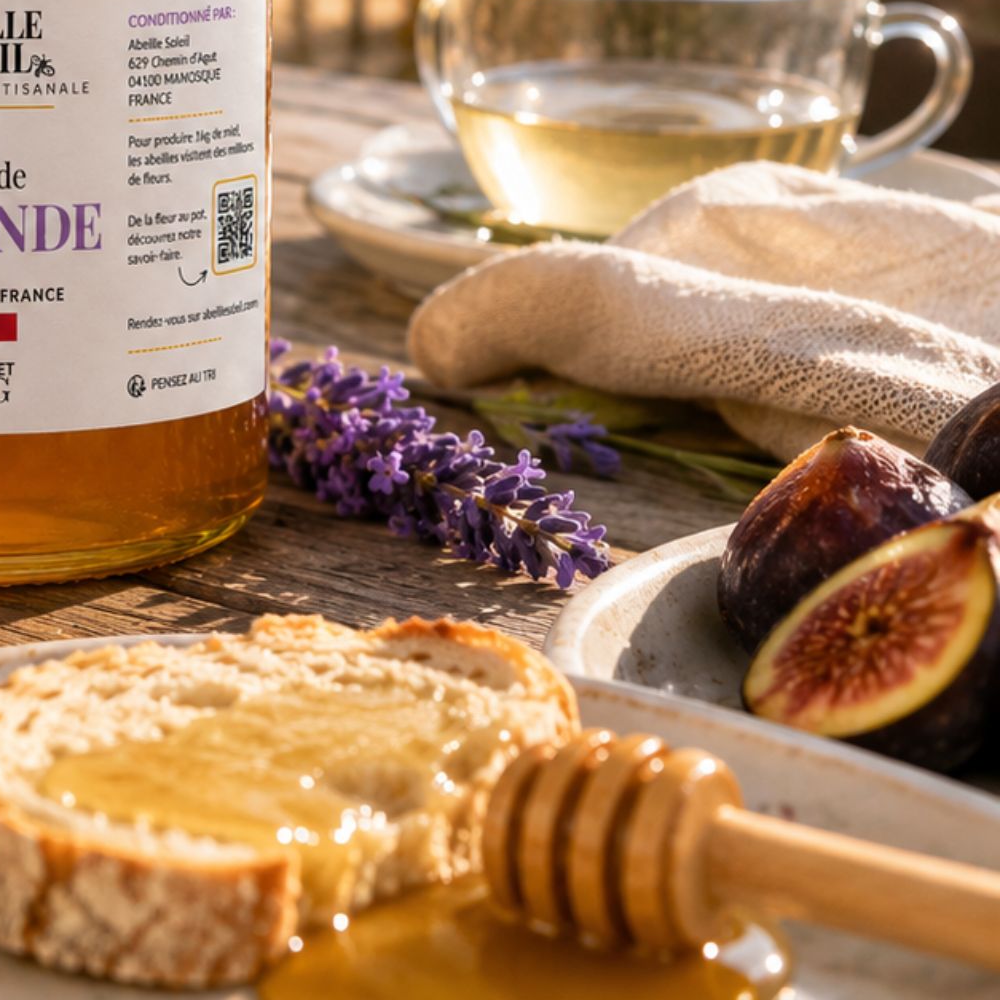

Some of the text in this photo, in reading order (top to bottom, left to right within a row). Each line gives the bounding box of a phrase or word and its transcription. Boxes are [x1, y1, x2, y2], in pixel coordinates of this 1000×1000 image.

[129, 5, 210, 27] CONDITIONNÉ
[128, 35, 190, 50] Abeille Soleil
[128, 57, 149, 69] 629
[151, 55, 188, 68] Chemin
[128, 68, 221, 88] 04100 MANOSQUE
[129, 92, 172, 107] FRANCE
[129, 136, 152, 149] Pour
[154, 134, 193, 148] produire
[212, 129, 222, 139] de
[128, 155, 142, 166] les
[144, 153, 179, 165] abeilles
[214, 146, 227, 158] des
[128, 172, 172, 186] de fleurs.
[128, 215, 142, 228] De
[145, 214, 153, 225] la
[155, 213, 176, 224] fleur
[178, 213, 189, 222] au
[0, 287, 64, 302] FRANCE
[188, 312, 201, 322] sur
[152, 369, 216, 390] PENSEZ AU TRI
